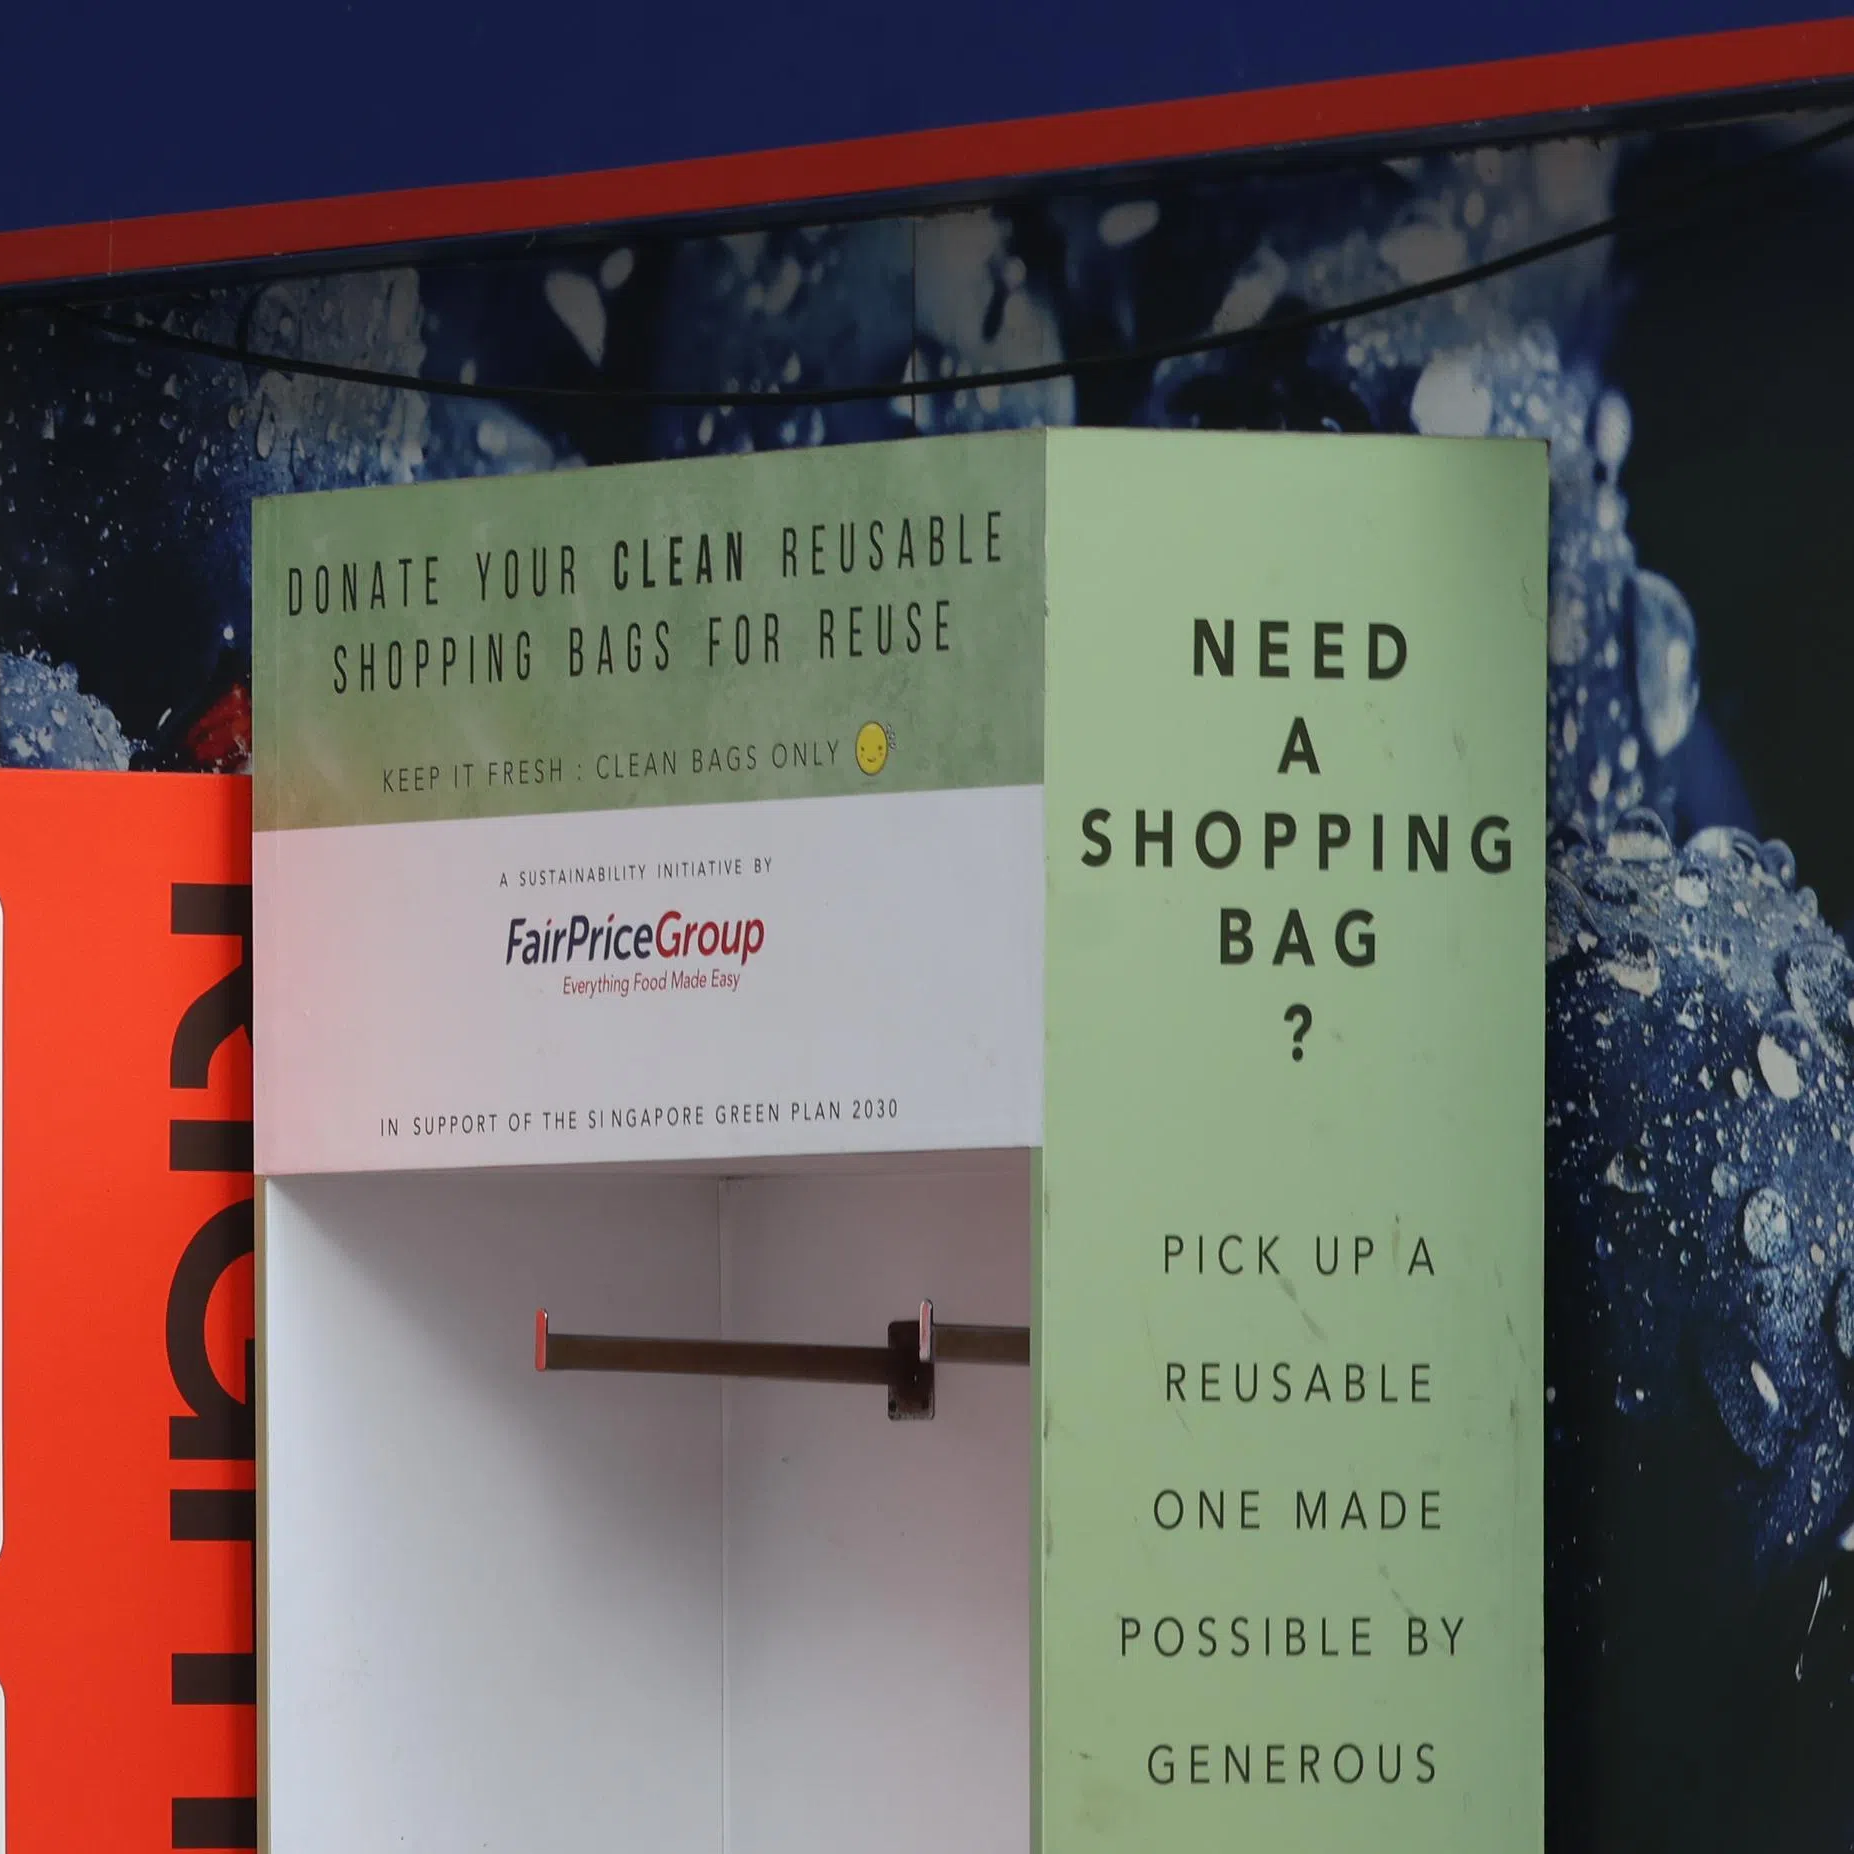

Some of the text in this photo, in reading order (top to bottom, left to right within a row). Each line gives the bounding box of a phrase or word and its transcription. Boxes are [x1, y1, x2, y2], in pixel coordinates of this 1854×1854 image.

[289, 511, 1000, 616] DONATE YOUR CLEAN REUSABLE
[334, 600, 949, 694] SHOPPING BAGS FOR REUSE
[1194, 618, 1407, 680] NEED
[384, 740, 838, 792] KEEP IT FRESH CLEAN BAGS ONLY
[1278, 717, 1320, 774] A
[1081, 808, 1511, 874] SHOPPING
[500, 858, 771, 887] A SUSTAINABILITY INITIATIVE BY
[506, 911, 764, 965] FairPriceGroup
[1220, 908, 1375, 967] BAG
[563, 968, 740, 999] Everything Food Made Easy
[1284, 1004, 1312, 1062] ?
[1165, 1235, 1434, 1275] PICK UP A
[1167, 1363, 1430, 1402] REUSABLE
[1154, 1490, 1440, 1530] ONE MADE
[1122, 1617, 1463, 1657] POSSIBLE BY
[1148, 1743, 1435, 1785] GENEROUS
